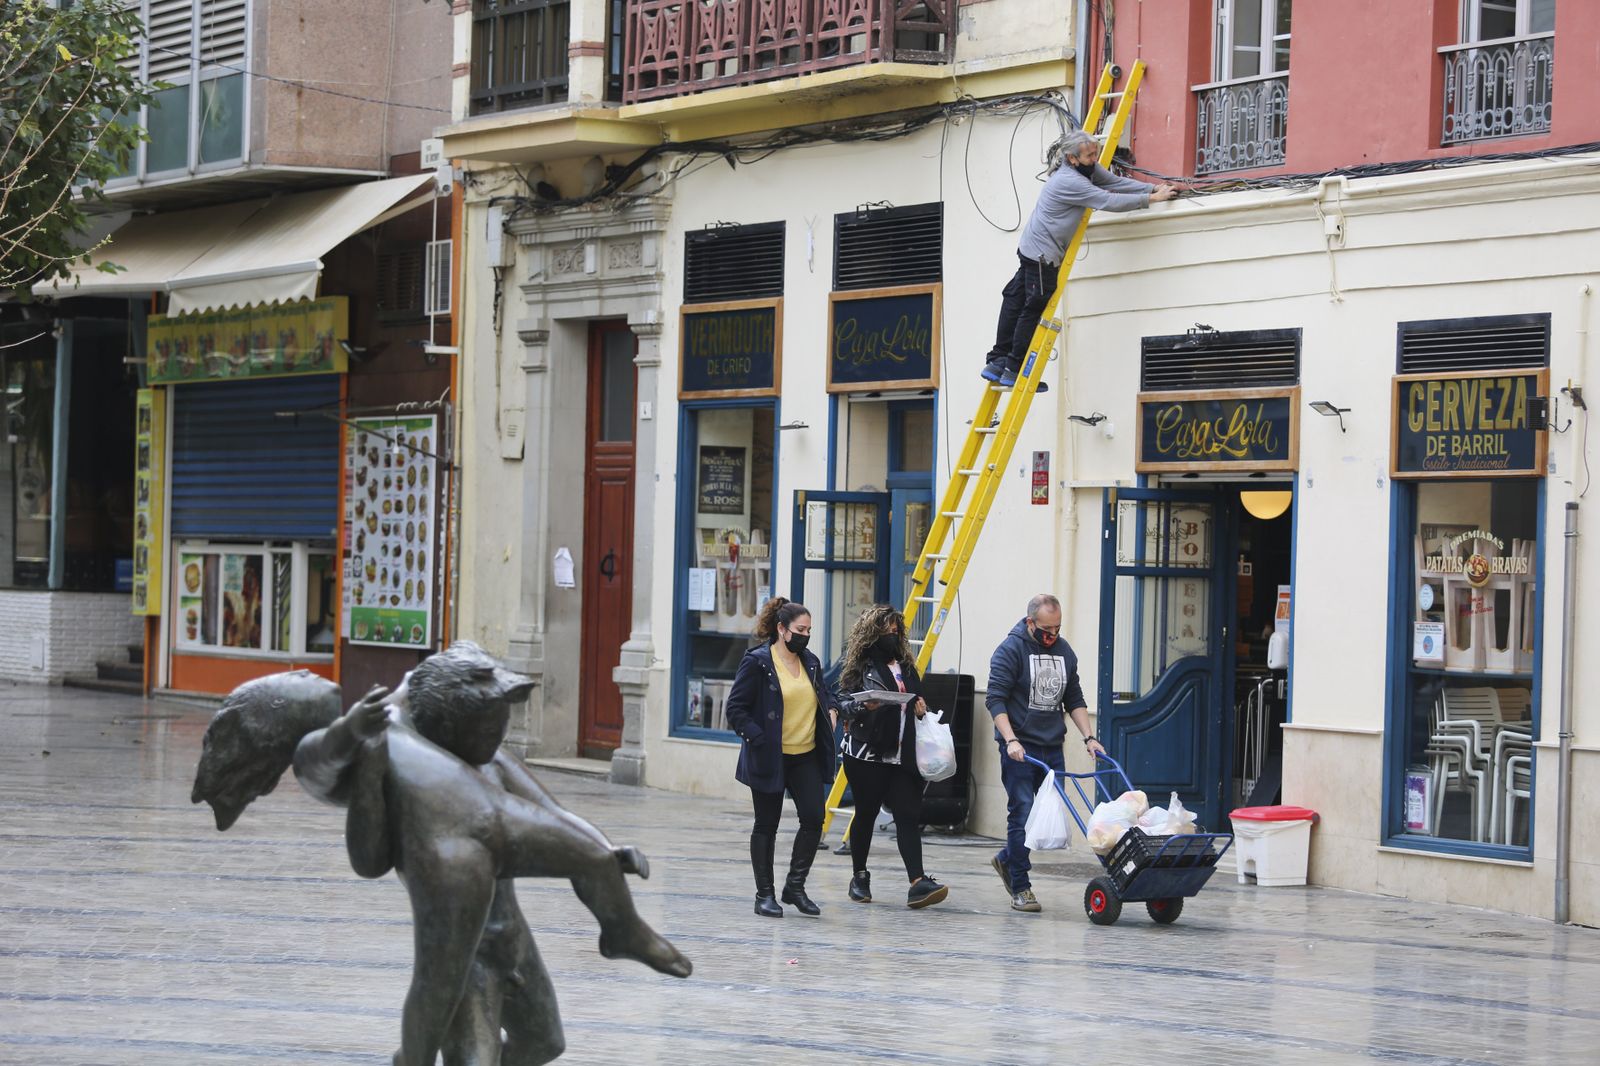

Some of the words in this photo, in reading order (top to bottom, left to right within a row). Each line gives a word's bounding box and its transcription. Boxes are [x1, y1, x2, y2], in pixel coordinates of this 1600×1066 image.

[690, 314, 773, 356] VERMOUTH
[836, 317, 879, 366] Casa
[881, 313, 929, 361] Lola
[707, 359, 720, 375] DE
[722, 357, 752, 375] GRIFO
[1408, 377, 1528, 432] CERVEZA
[1156, 404, 1213, 458] Casa
[1212, 403, 1278, 457] Lola
[1426, 435, 1447, 456] DE
[1451, 433, 1508, 456] BARRIL
[1422, 455, 1450, 471] Estilo
[1452, 452, 1511, 470] Tradicional
[1449, 529, 1505, 551] PREMIADAS
[1426, 556, 1463, 574] PATATAS
[1491, 556, 1528, 574] BRAVAS
[1038, 677, 1059, 689] NYC
